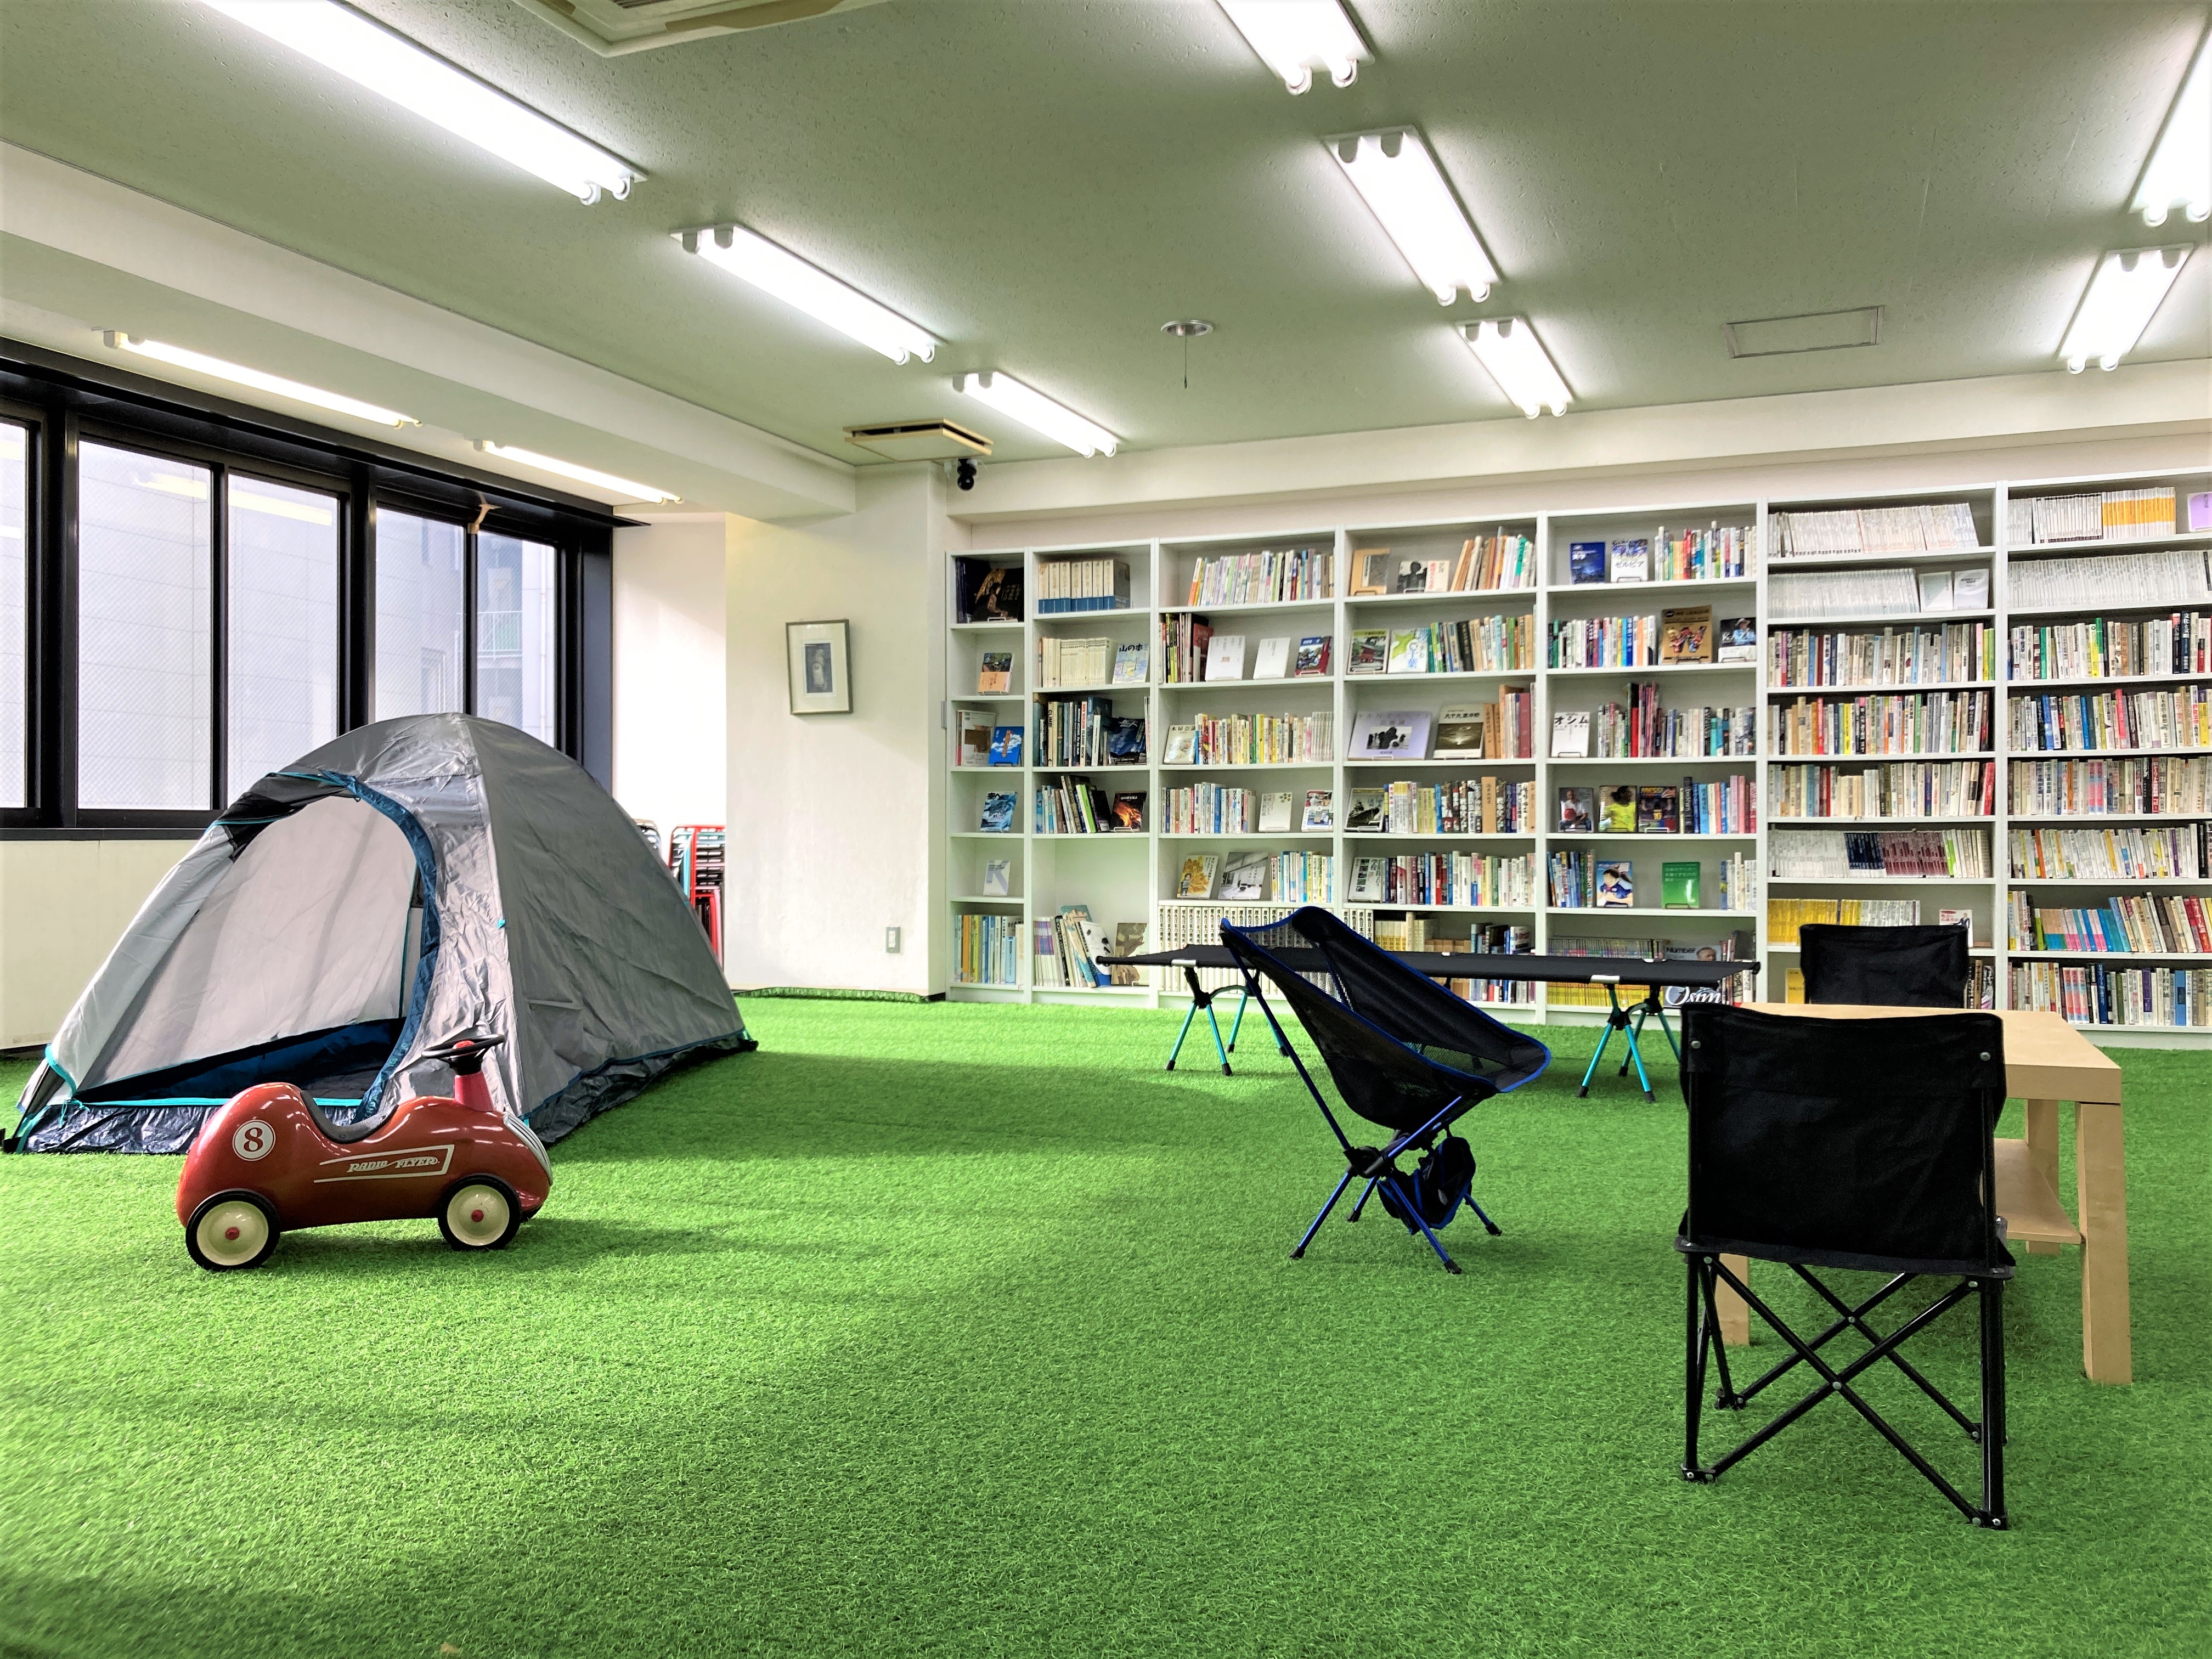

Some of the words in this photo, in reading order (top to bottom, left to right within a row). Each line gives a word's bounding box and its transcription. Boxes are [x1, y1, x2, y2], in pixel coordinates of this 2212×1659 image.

[1119, 644, 1143, 652] 山の本
[243, 1127, 264, 1151] 8
[347, 1160, 389, 1173] RADIO
[395, 1156, 439, 1169] FLYER
